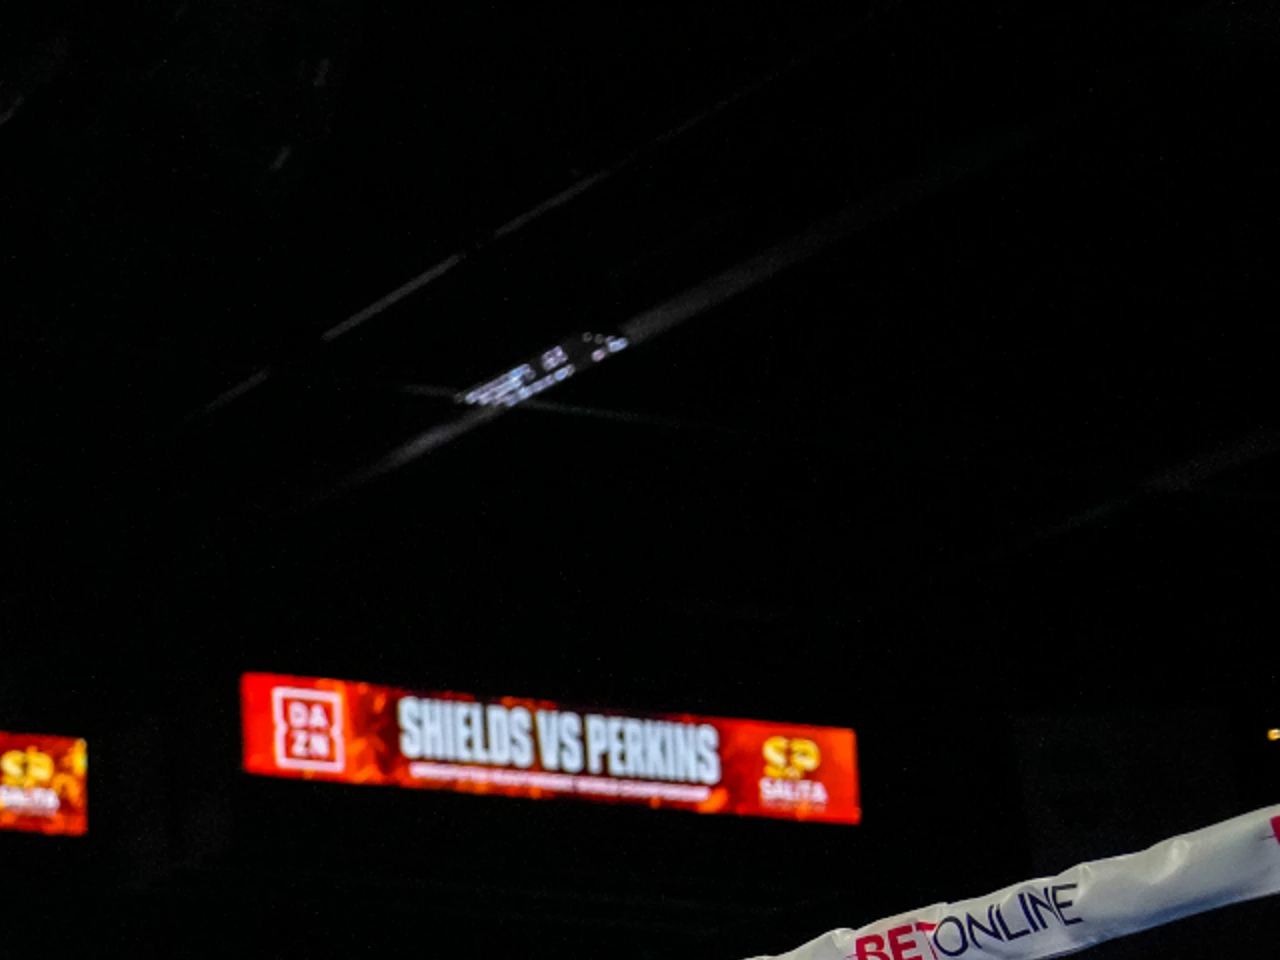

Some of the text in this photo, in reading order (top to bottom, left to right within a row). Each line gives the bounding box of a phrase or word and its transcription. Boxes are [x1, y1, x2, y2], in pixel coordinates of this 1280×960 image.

[398, 696, 535, 767] SHIELDS
[540, 708, 583, 773] VS
[586, 713, 721, 785] PERKINS
[759, 777, 828, 804] SALITA
